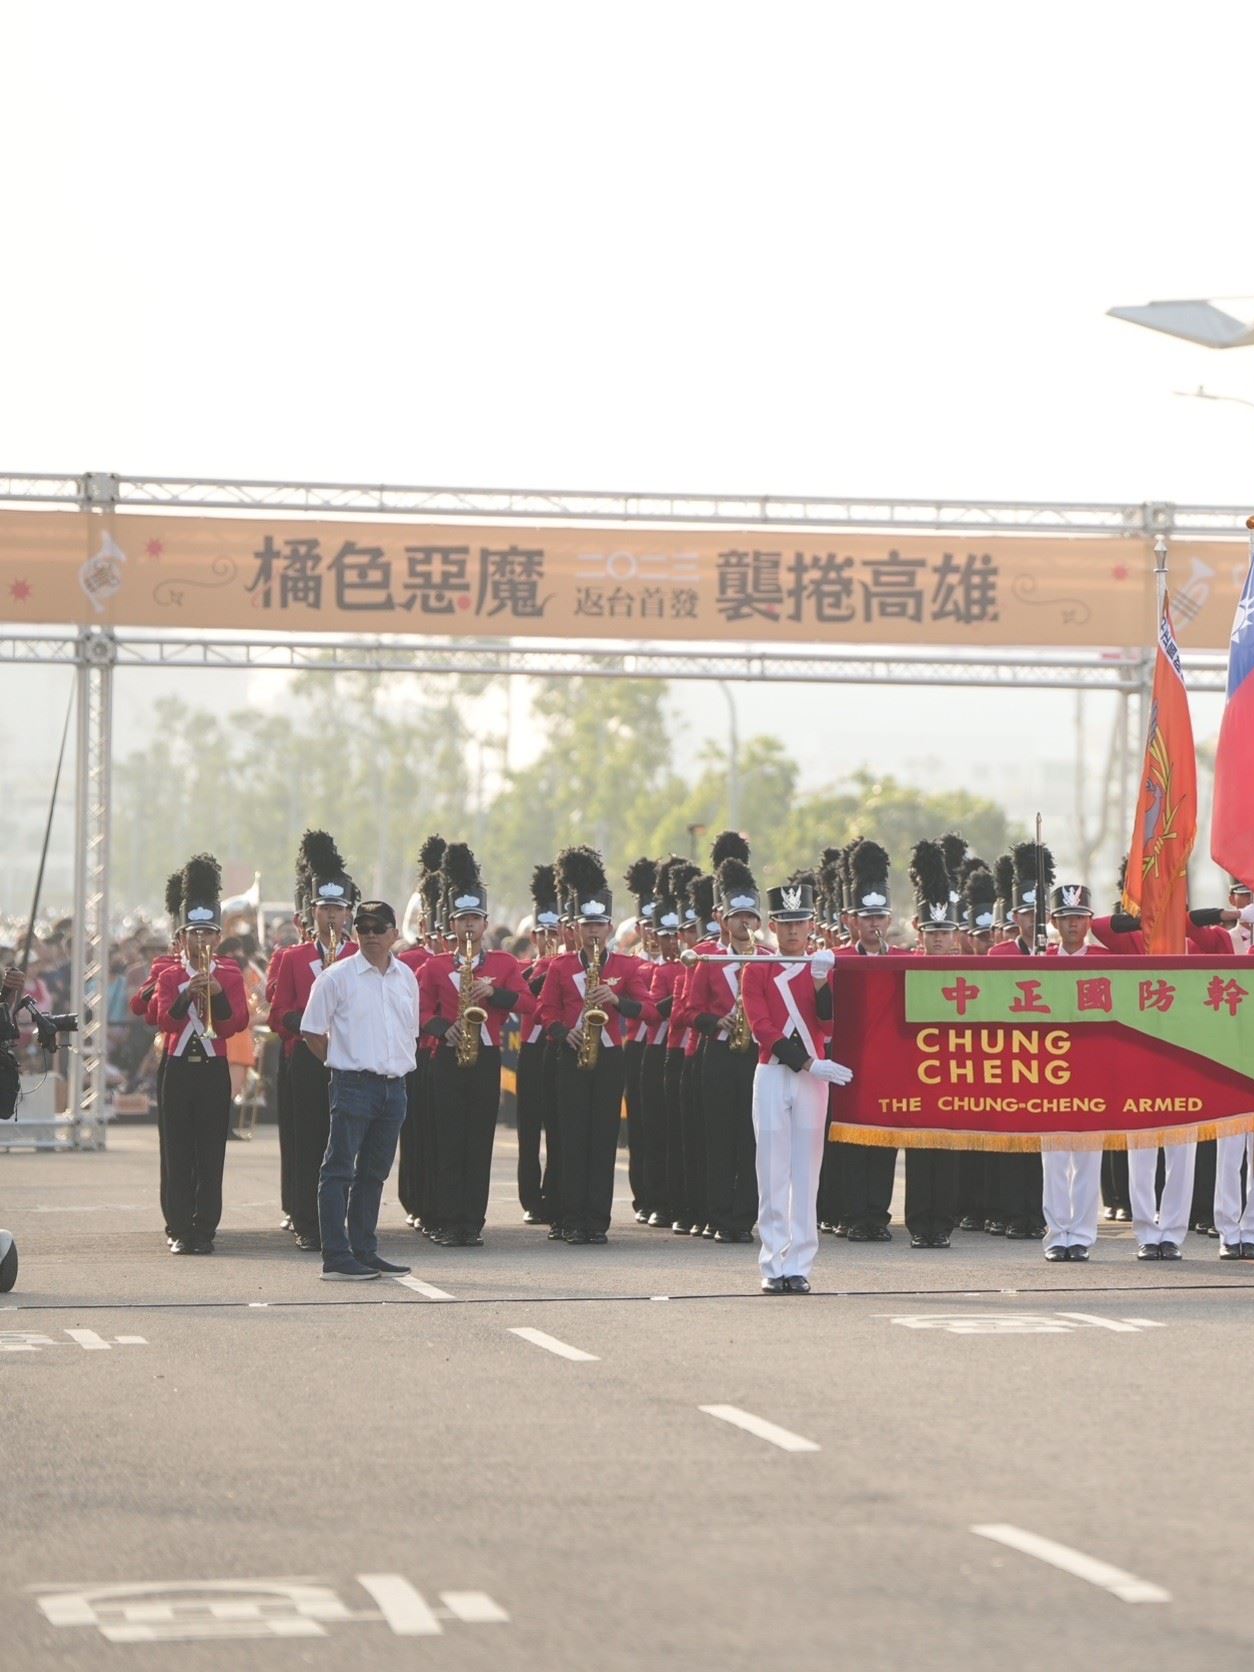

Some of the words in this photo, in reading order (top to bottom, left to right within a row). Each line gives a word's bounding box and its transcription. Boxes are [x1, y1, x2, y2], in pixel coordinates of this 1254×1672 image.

[244, 534, 551, 618] 橘色惡魔
[716, 548, 1000, 626] 襲捲高雄
[574, 586, 699, 619] 返台首發
[916, 1027, 1071, 1055] CHUNG
[917, 1059, 1071, 1085] CHENG
[879, 1098, 921, 1113] THE
[937, 1096, 1106, 1113] CHUNG-CHENG
[1123, 1097, 1203, 1113] ARMED
